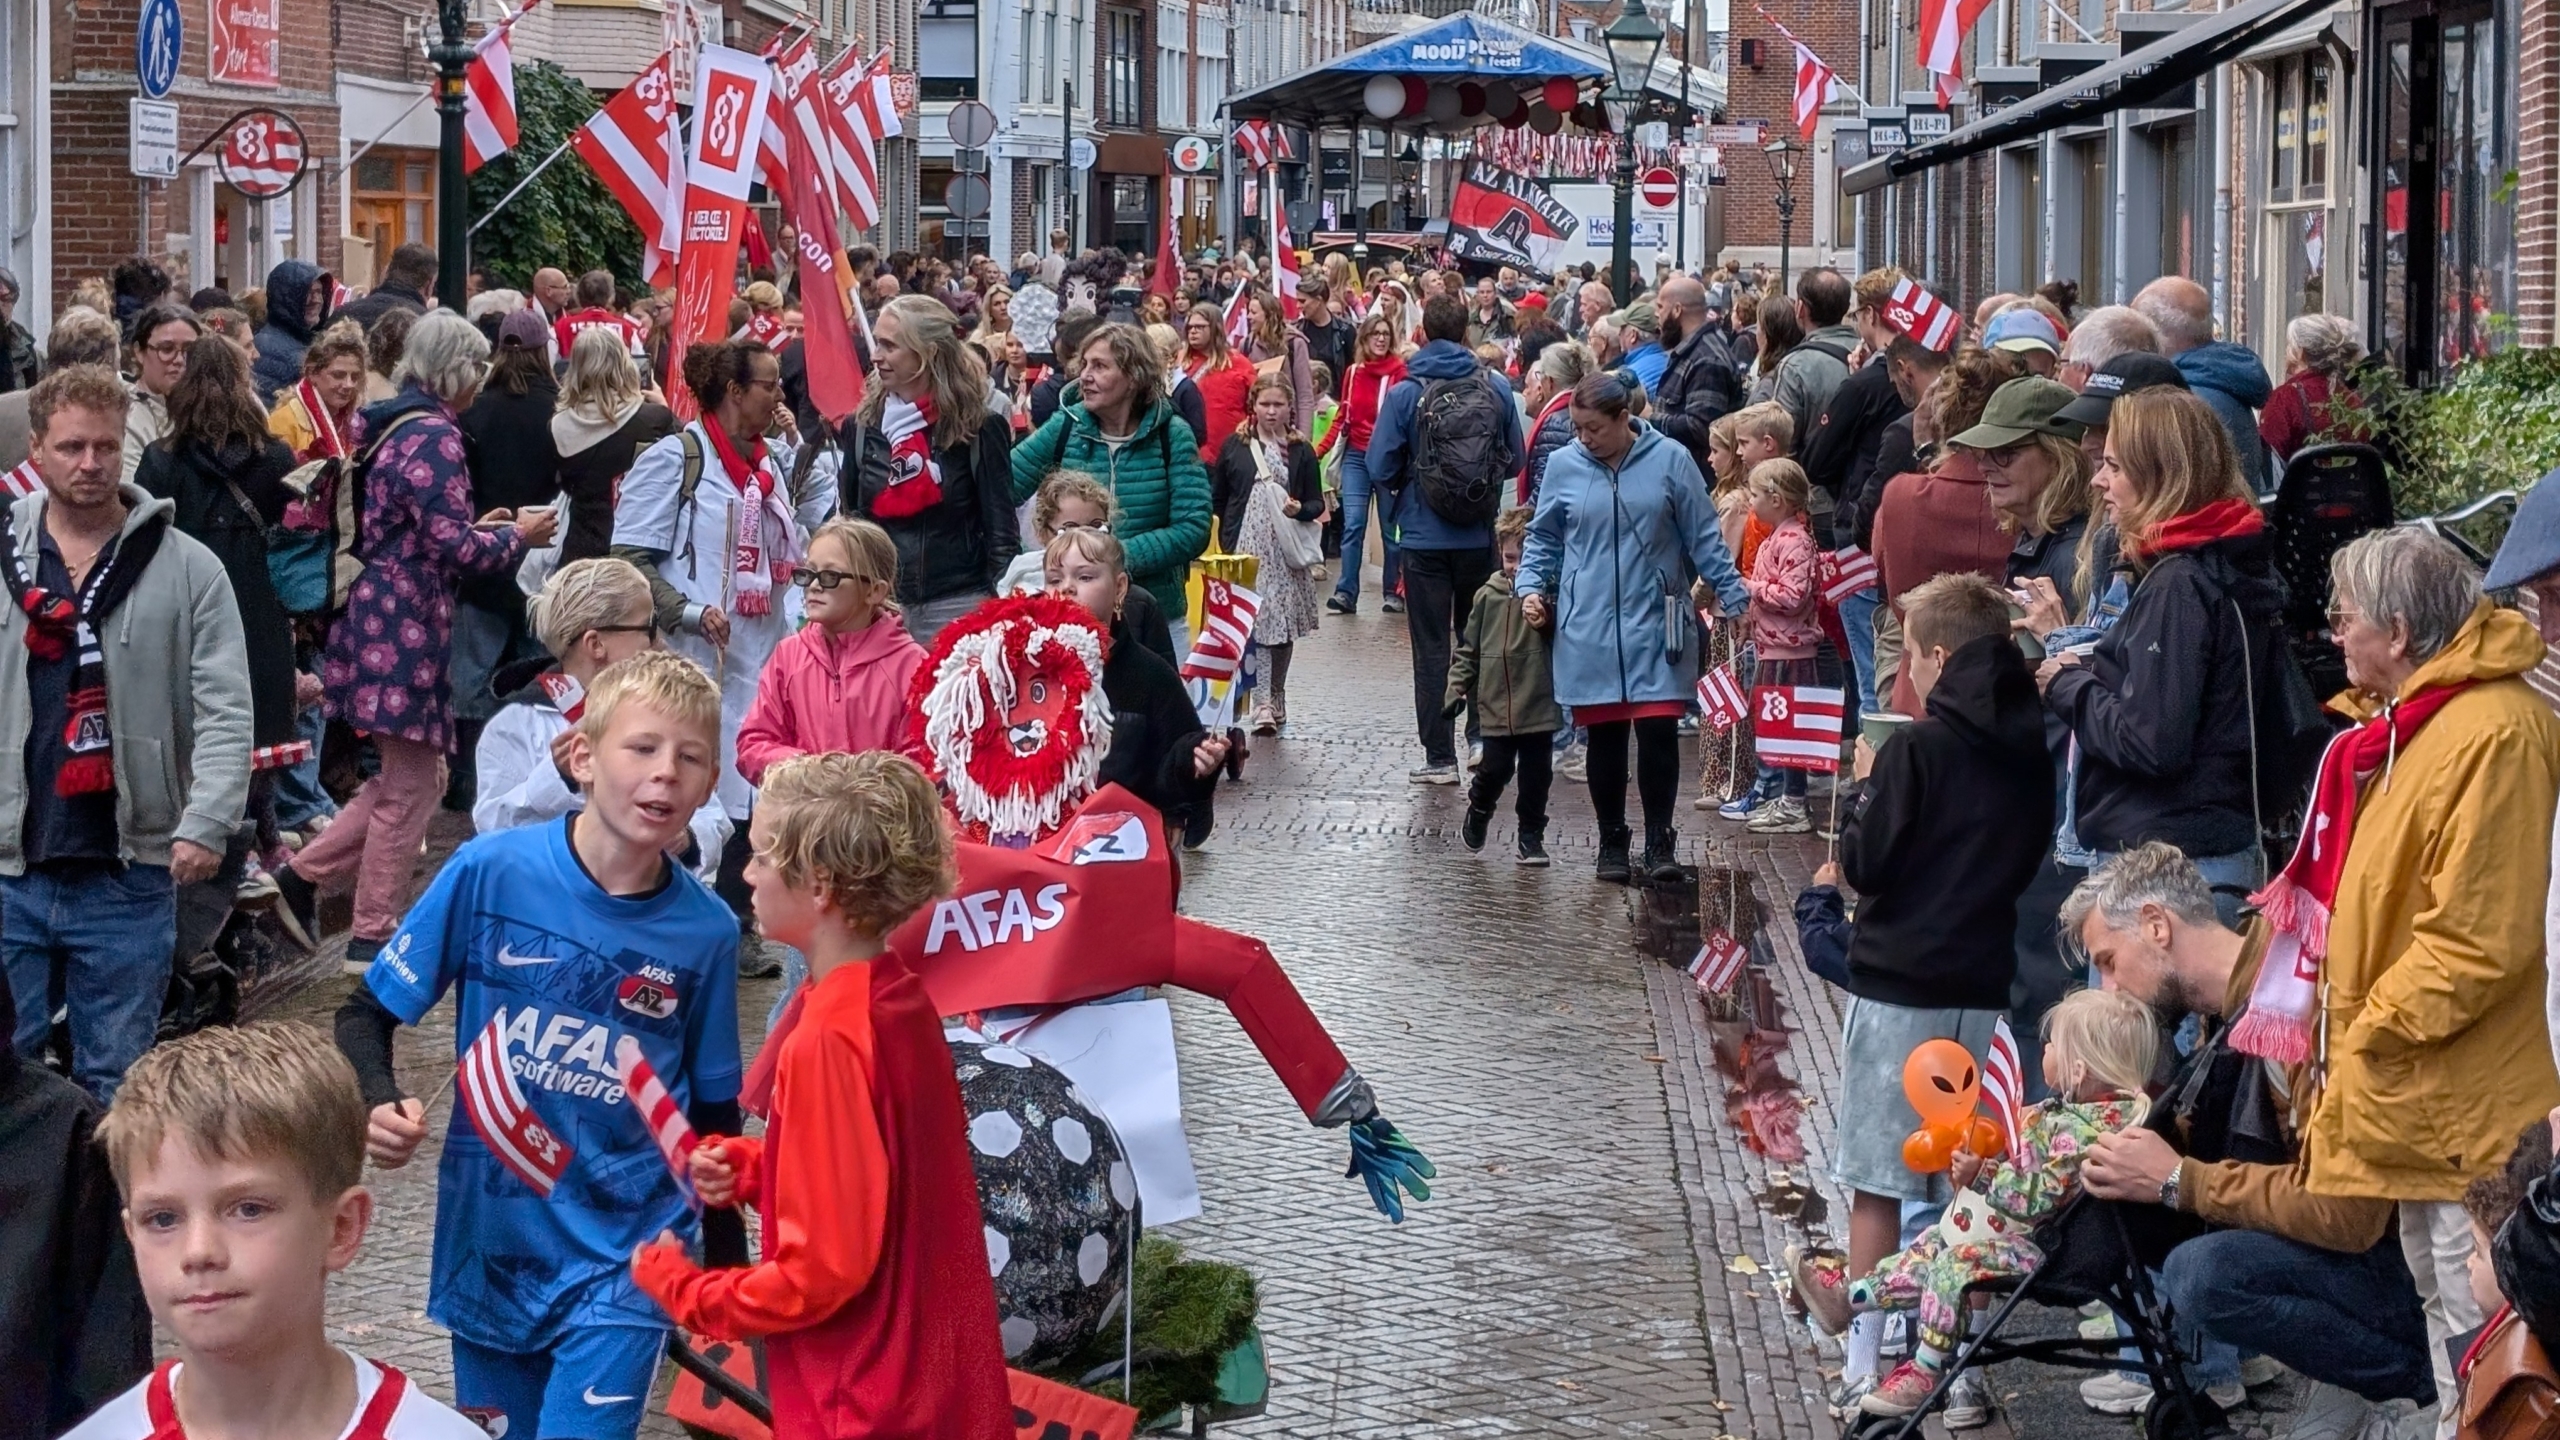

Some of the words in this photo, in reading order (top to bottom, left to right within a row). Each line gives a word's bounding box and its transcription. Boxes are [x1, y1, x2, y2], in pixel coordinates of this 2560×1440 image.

[1411, 44, 1466, 60] MOOIJ
[1489, 56, 1521, 67] feest!
[1913, 118, 1947, 131] Hi-Fi
[1874, 130, 1905, 142] Hi-Fi
[1872, 145, 1906, 154] klubbn
[1470, 159, 1501, 189] AZ
[1502, 174, 1578, 232] ALKMAAR
[923, 883, 1069, 957] AFAS
[638, 964, 677, 986] AFAS
[625, 983, 665, 1016] AZ
[509, 1053, 627, 1106] software
